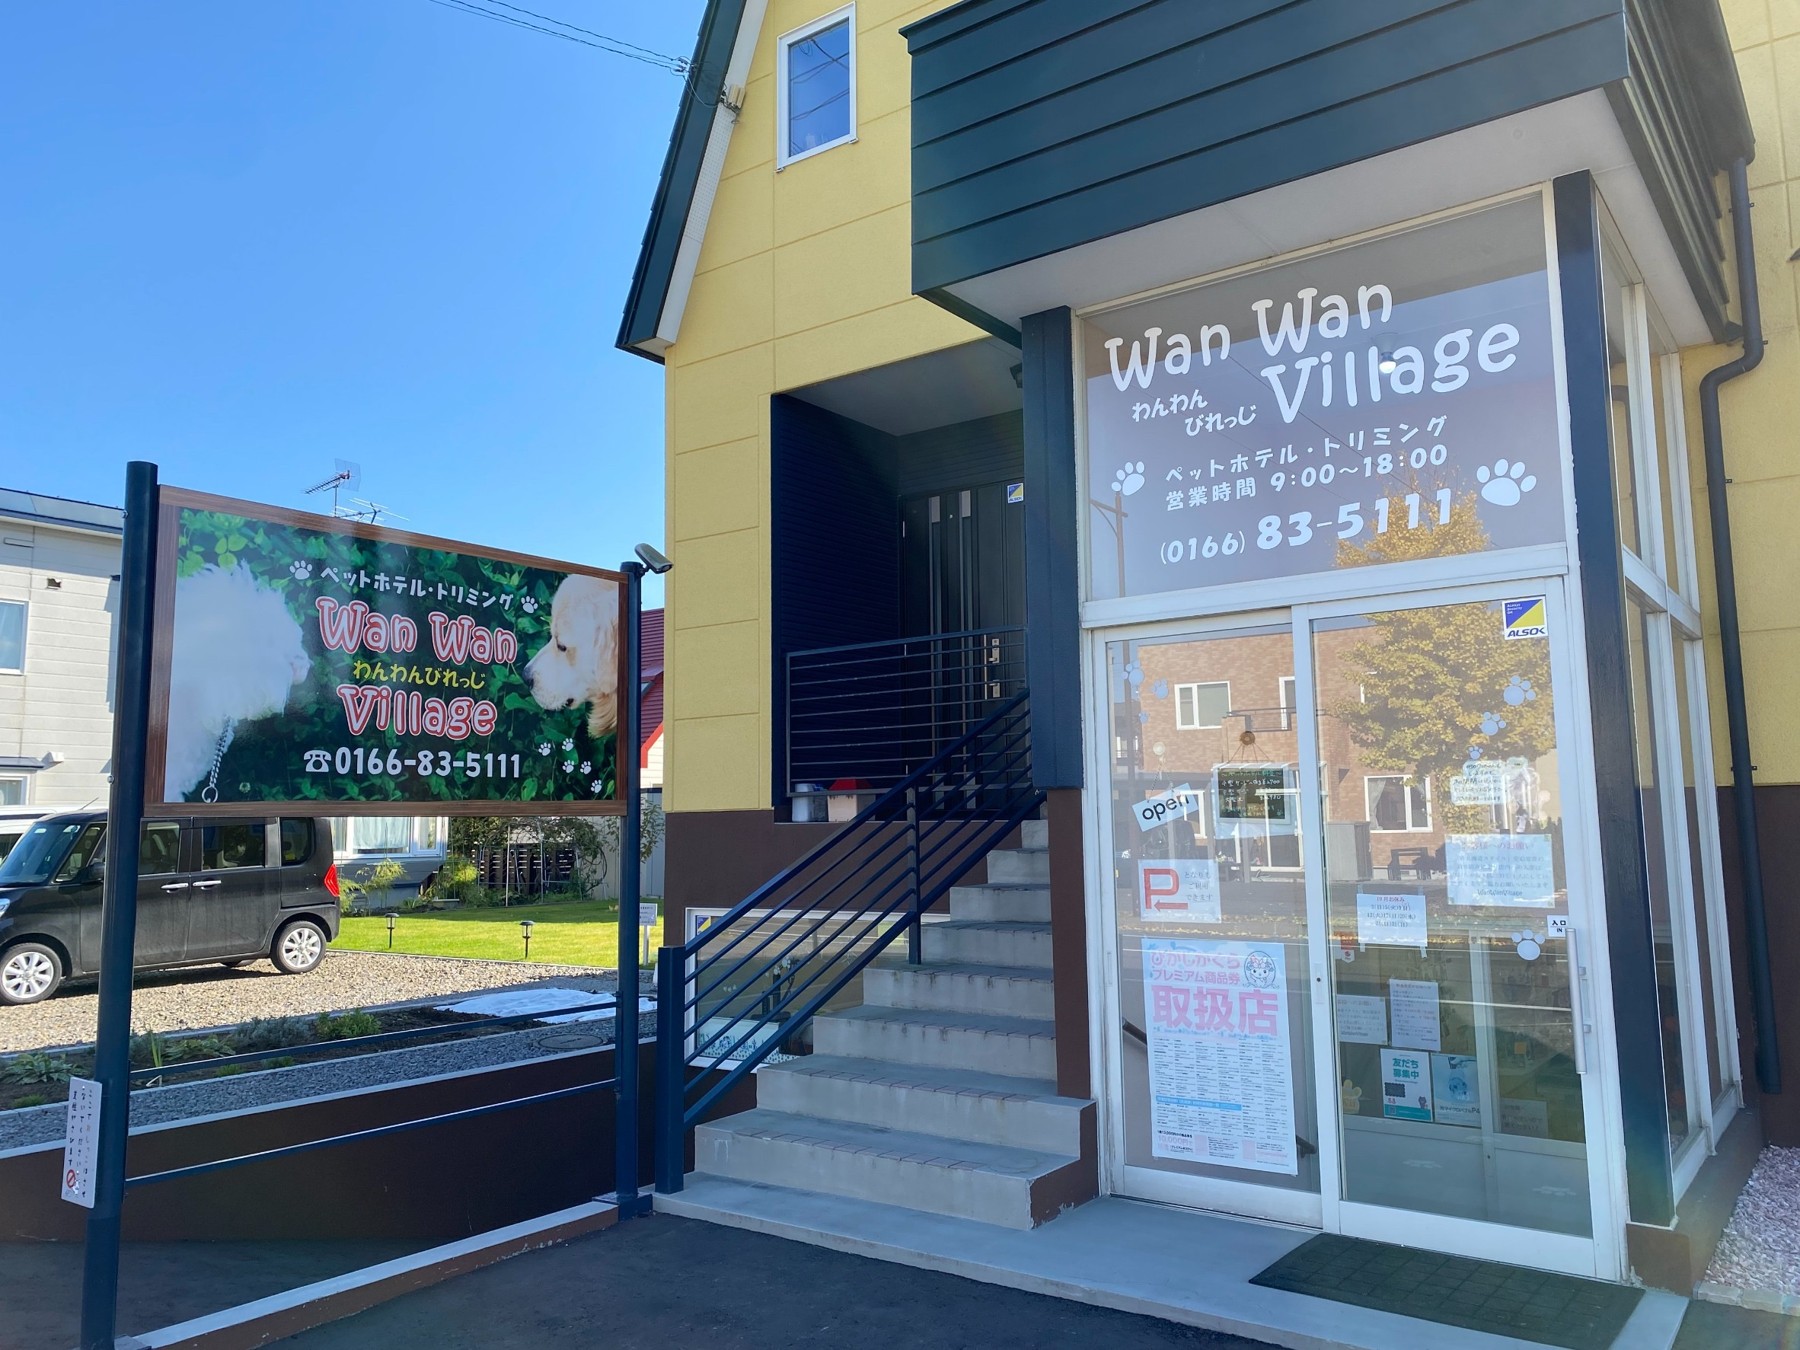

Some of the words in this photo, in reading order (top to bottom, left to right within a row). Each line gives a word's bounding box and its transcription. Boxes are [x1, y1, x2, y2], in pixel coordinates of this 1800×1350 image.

[1104, 324, 1231, 392] Wan
[1252, 284, 1393, 356] Wan
[1260, 322, 1520, 424] Village
[1131, 389, 1209, 422] わんわん
[1185, 405, 1257, 436] びれっじ
[1165, 415, 1448, 483] ペットホテル・トリミング
[1165, 479, 1256, 511] 営業時間
[1160, 531, 1246, 564] (0166)
[1256, 487, 1452, 550] 83-5111
[320, 567, 514, 610] ペットホテル・トリミング
[316, 596, 418, 654] Wan
[428, 611, 518, 665] Wan
[1507, 627, 1546, 637] ALSOK
[352, 659, 486, 690] わんわんびれっじ
[336, 684, 498, 741] Village
[335, 746, 520, 778] 0166-83-5111
[1142, 794, 1190, 821] open
[1153, 969, 1241, 986] プレミアム商品券
[1151, 985, 1279, 1037] 取扱店
[1392, 1058, 1419, 1069] 友だち
[1393, 1068, 1420, 1080] 募集中
